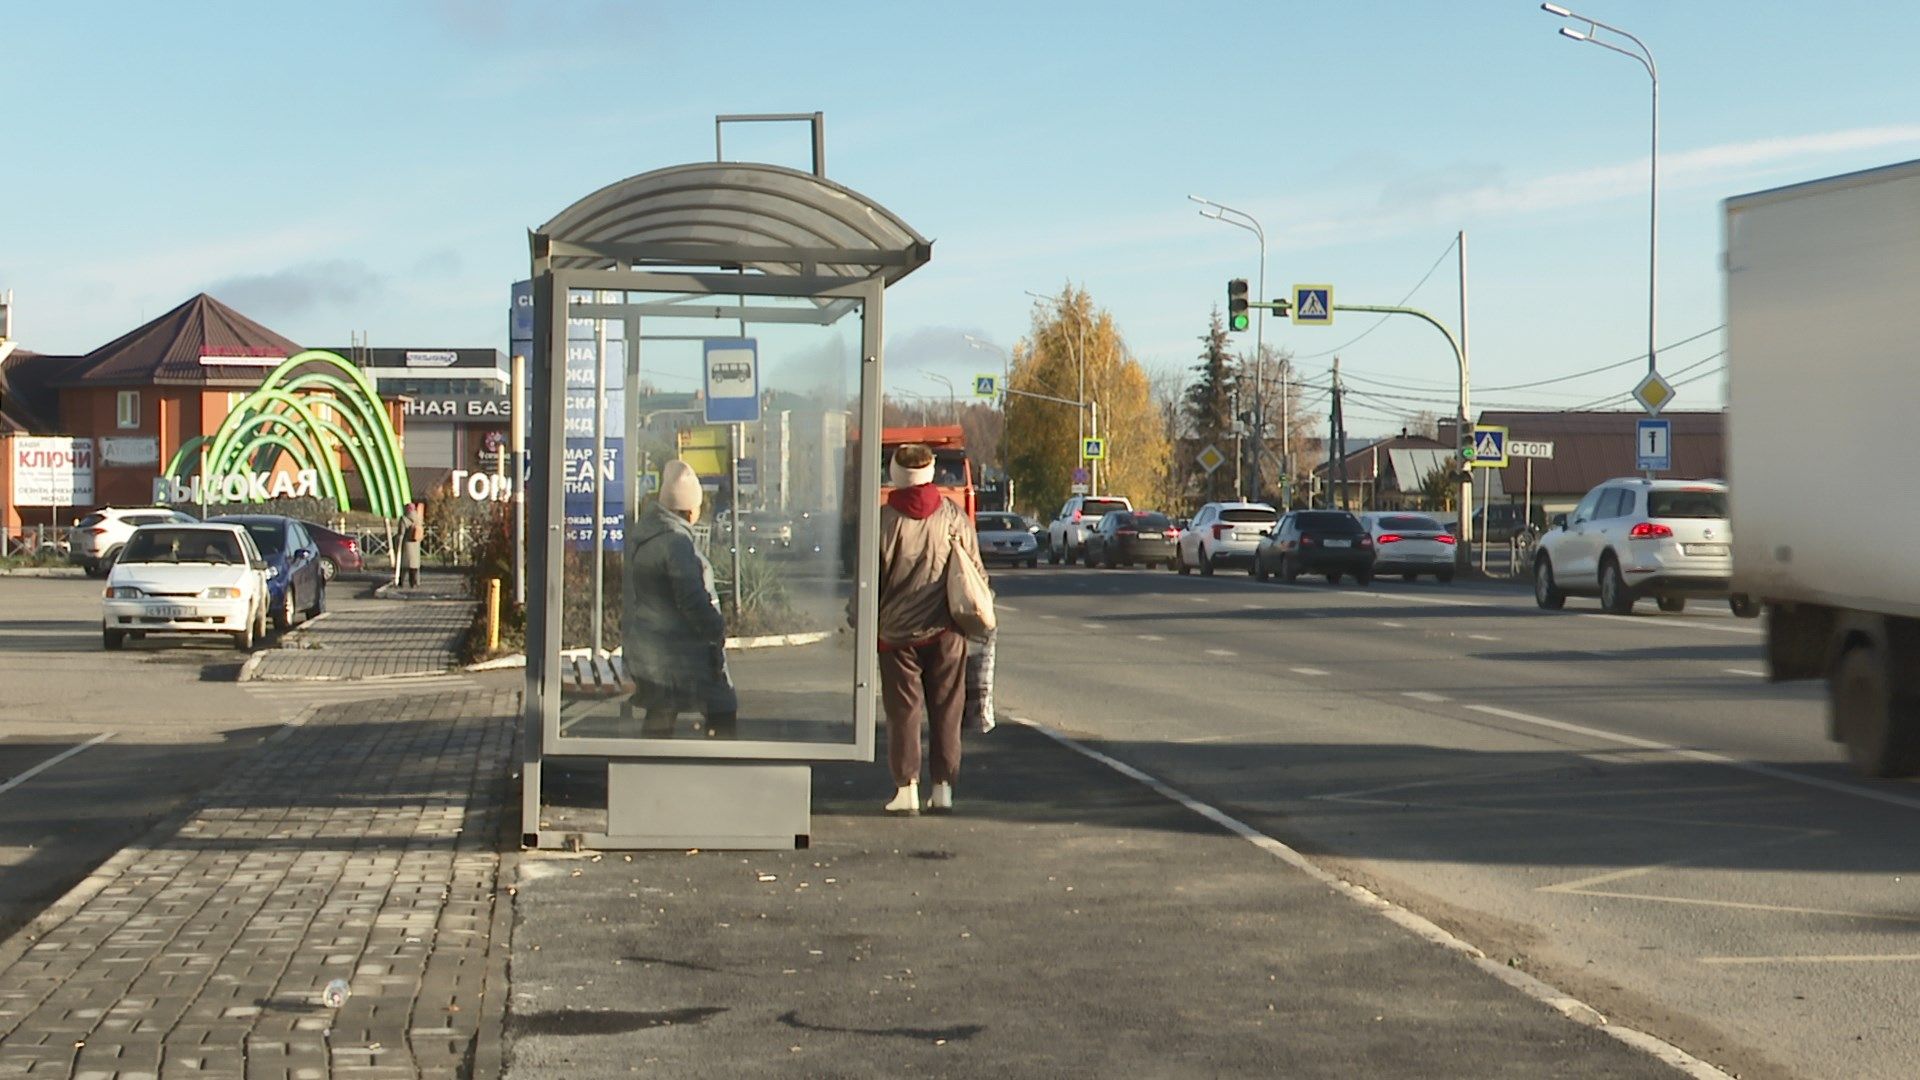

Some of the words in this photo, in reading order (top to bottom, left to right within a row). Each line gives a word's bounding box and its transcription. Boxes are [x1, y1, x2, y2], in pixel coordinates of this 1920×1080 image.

[1511, 443, 1547, 456] СТОП
[19, 451, 92, 468] КЛЮЧИ
[153, 469, 318, 503] ВЫСОКАЯ
